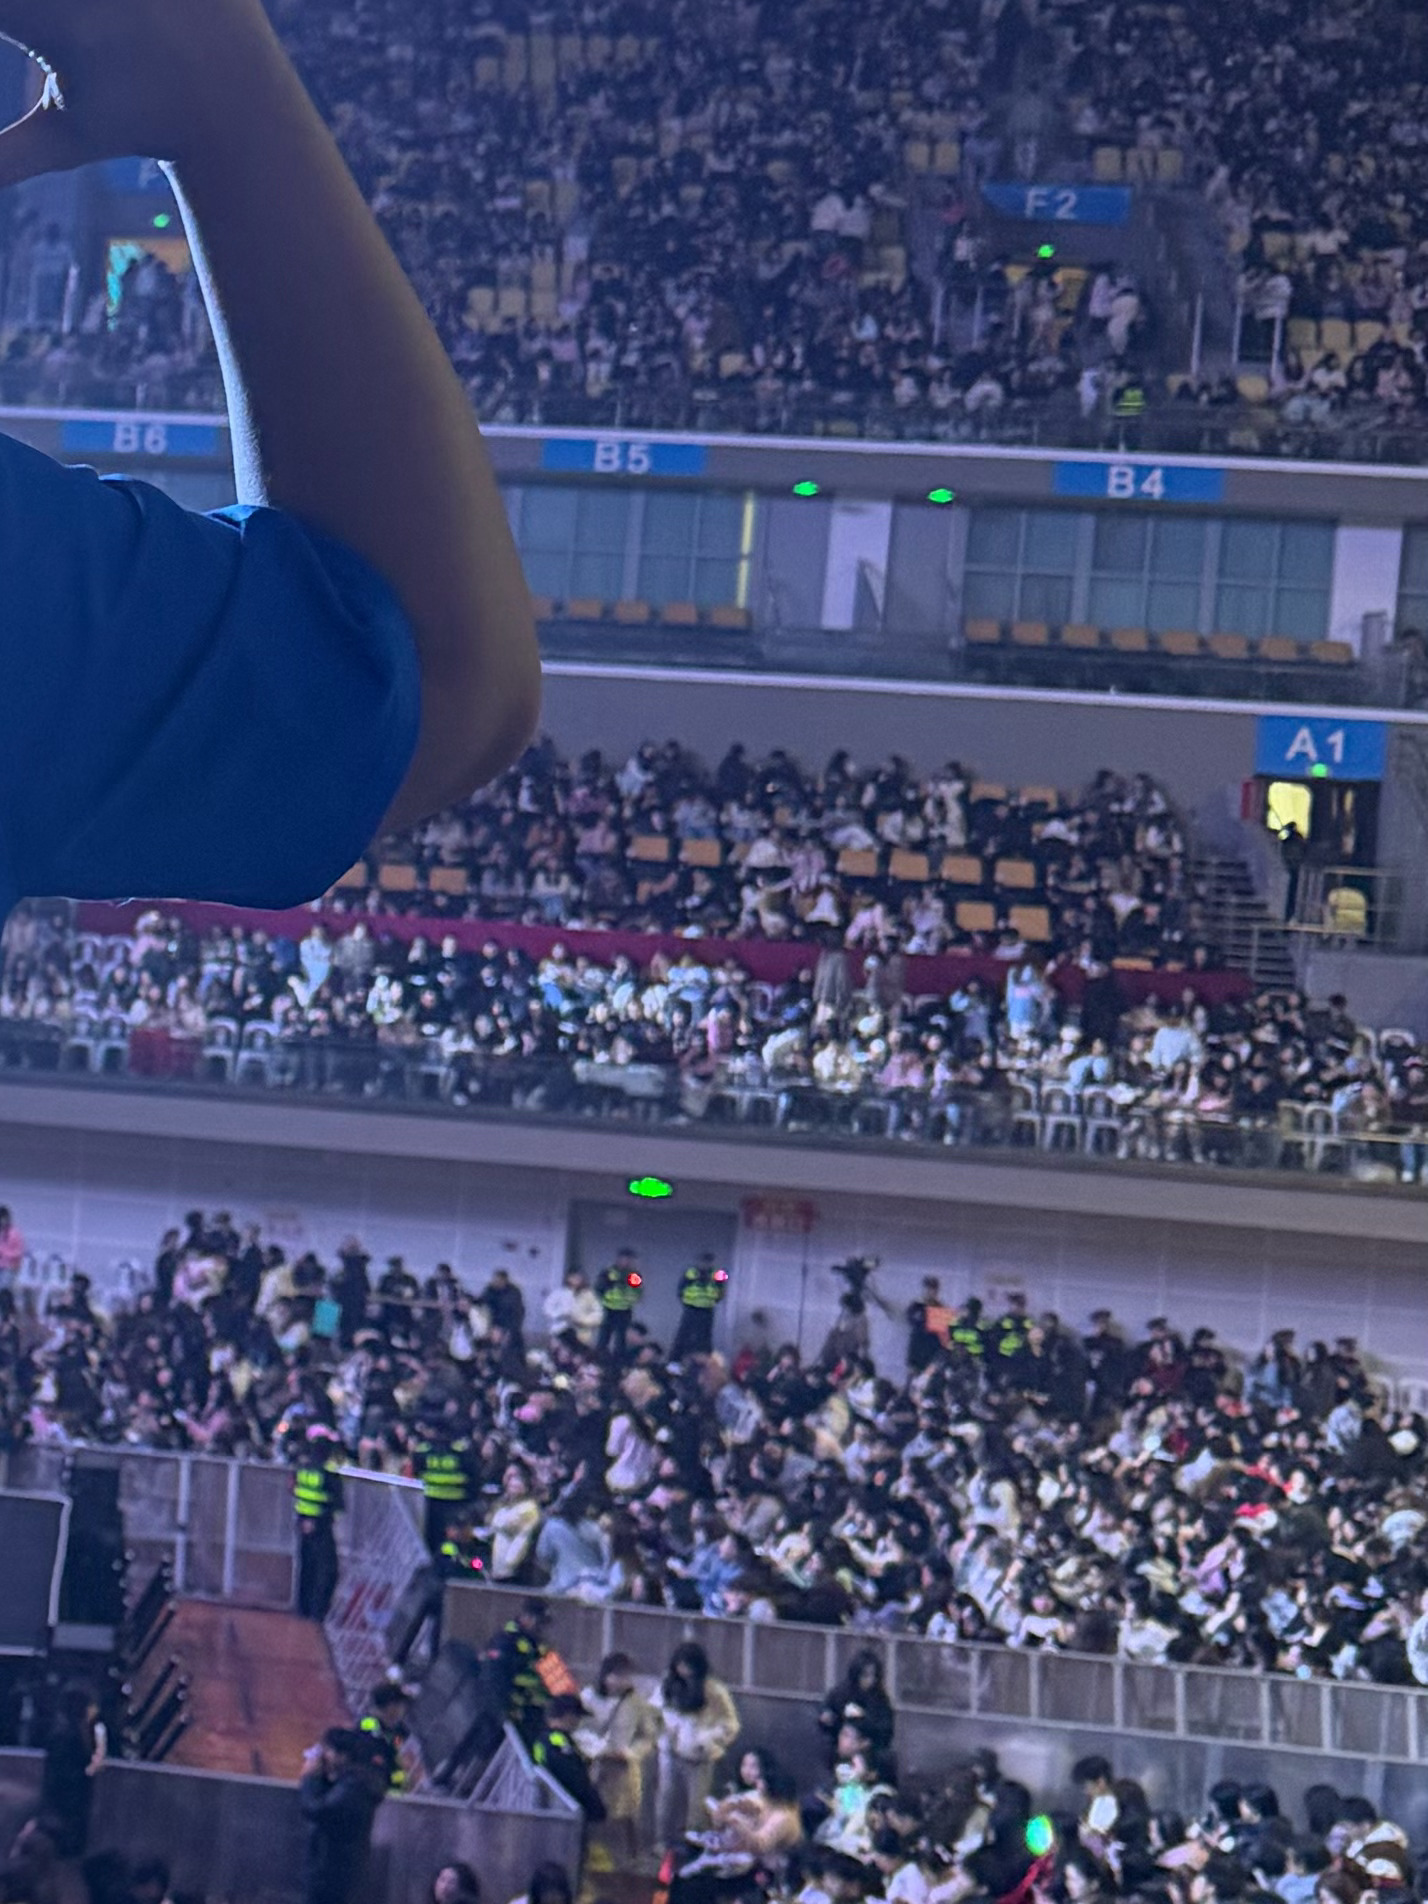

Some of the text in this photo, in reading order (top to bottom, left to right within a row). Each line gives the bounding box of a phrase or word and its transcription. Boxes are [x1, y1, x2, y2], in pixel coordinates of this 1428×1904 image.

[1024, 186, 1078, 220] F2
[113, 423, 167, 454] B6
[595, 442, 650, 473] B5
[1107, 464, 1165, 499] B4
[1285, 726, 1345, 763] A1
